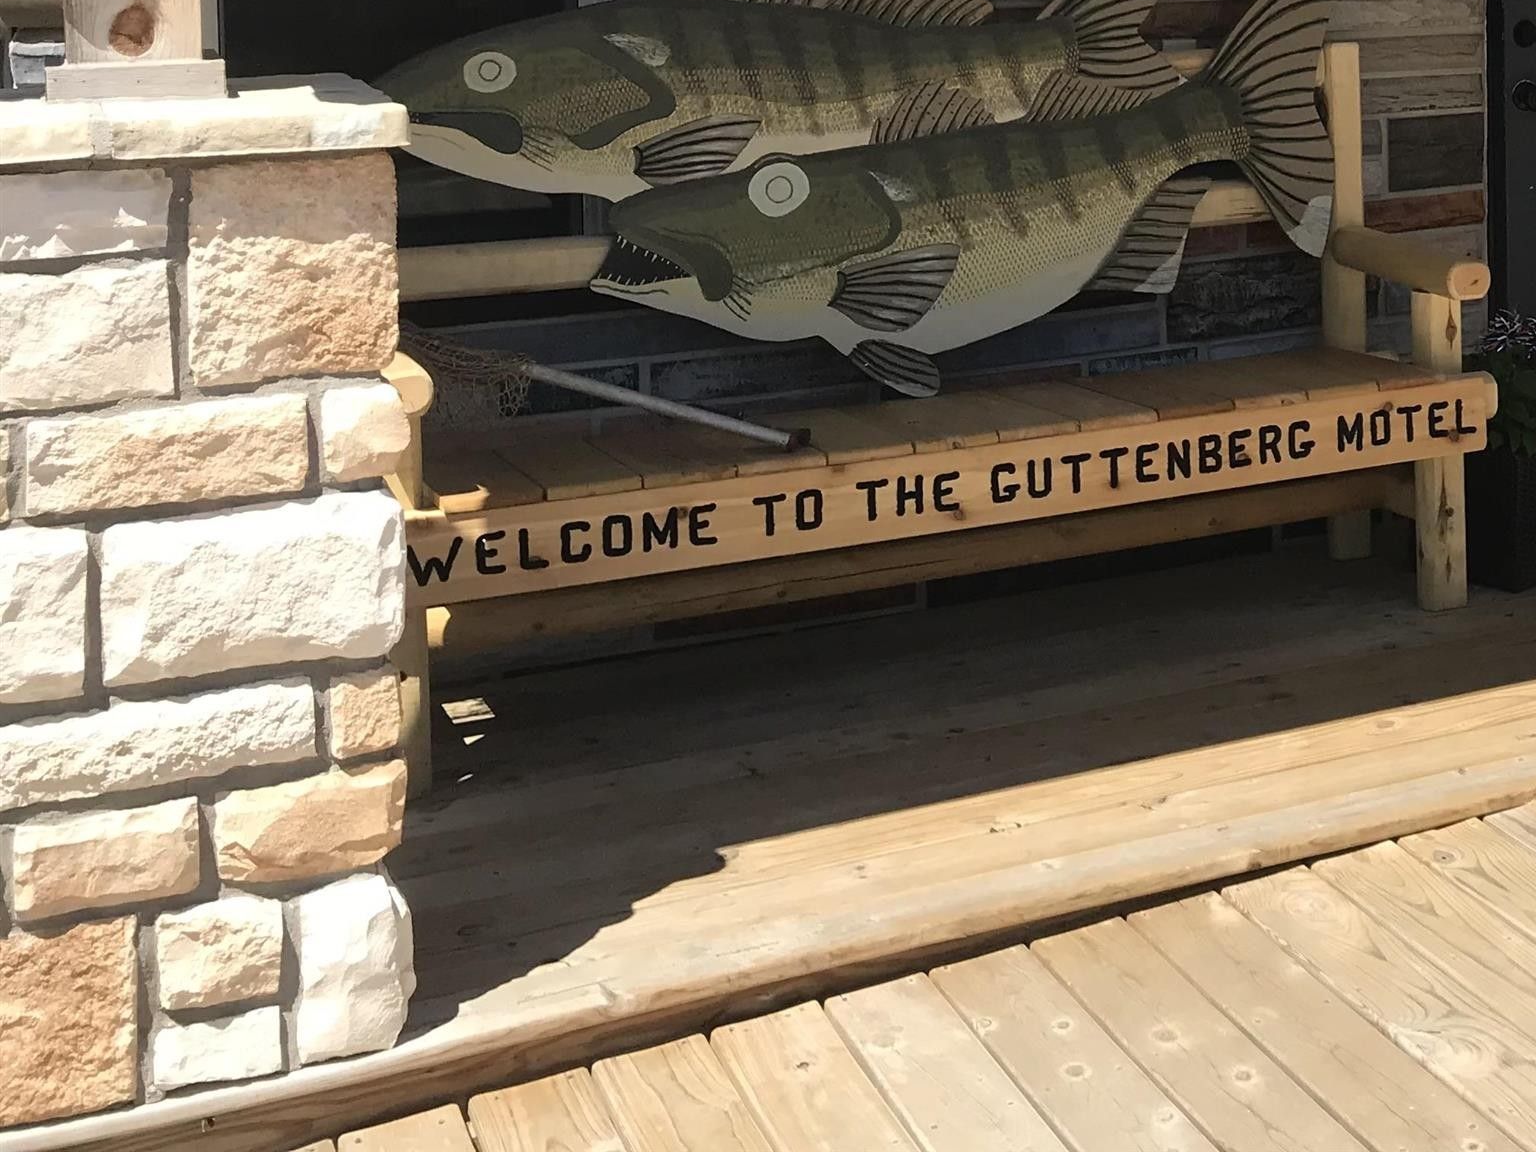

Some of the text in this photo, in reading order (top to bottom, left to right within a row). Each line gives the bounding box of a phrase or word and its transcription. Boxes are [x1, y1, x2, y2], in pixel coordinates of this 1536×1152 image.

[406, 398, 1477, 587] WELCOME TO THE GUTTENBERG MOTEL
